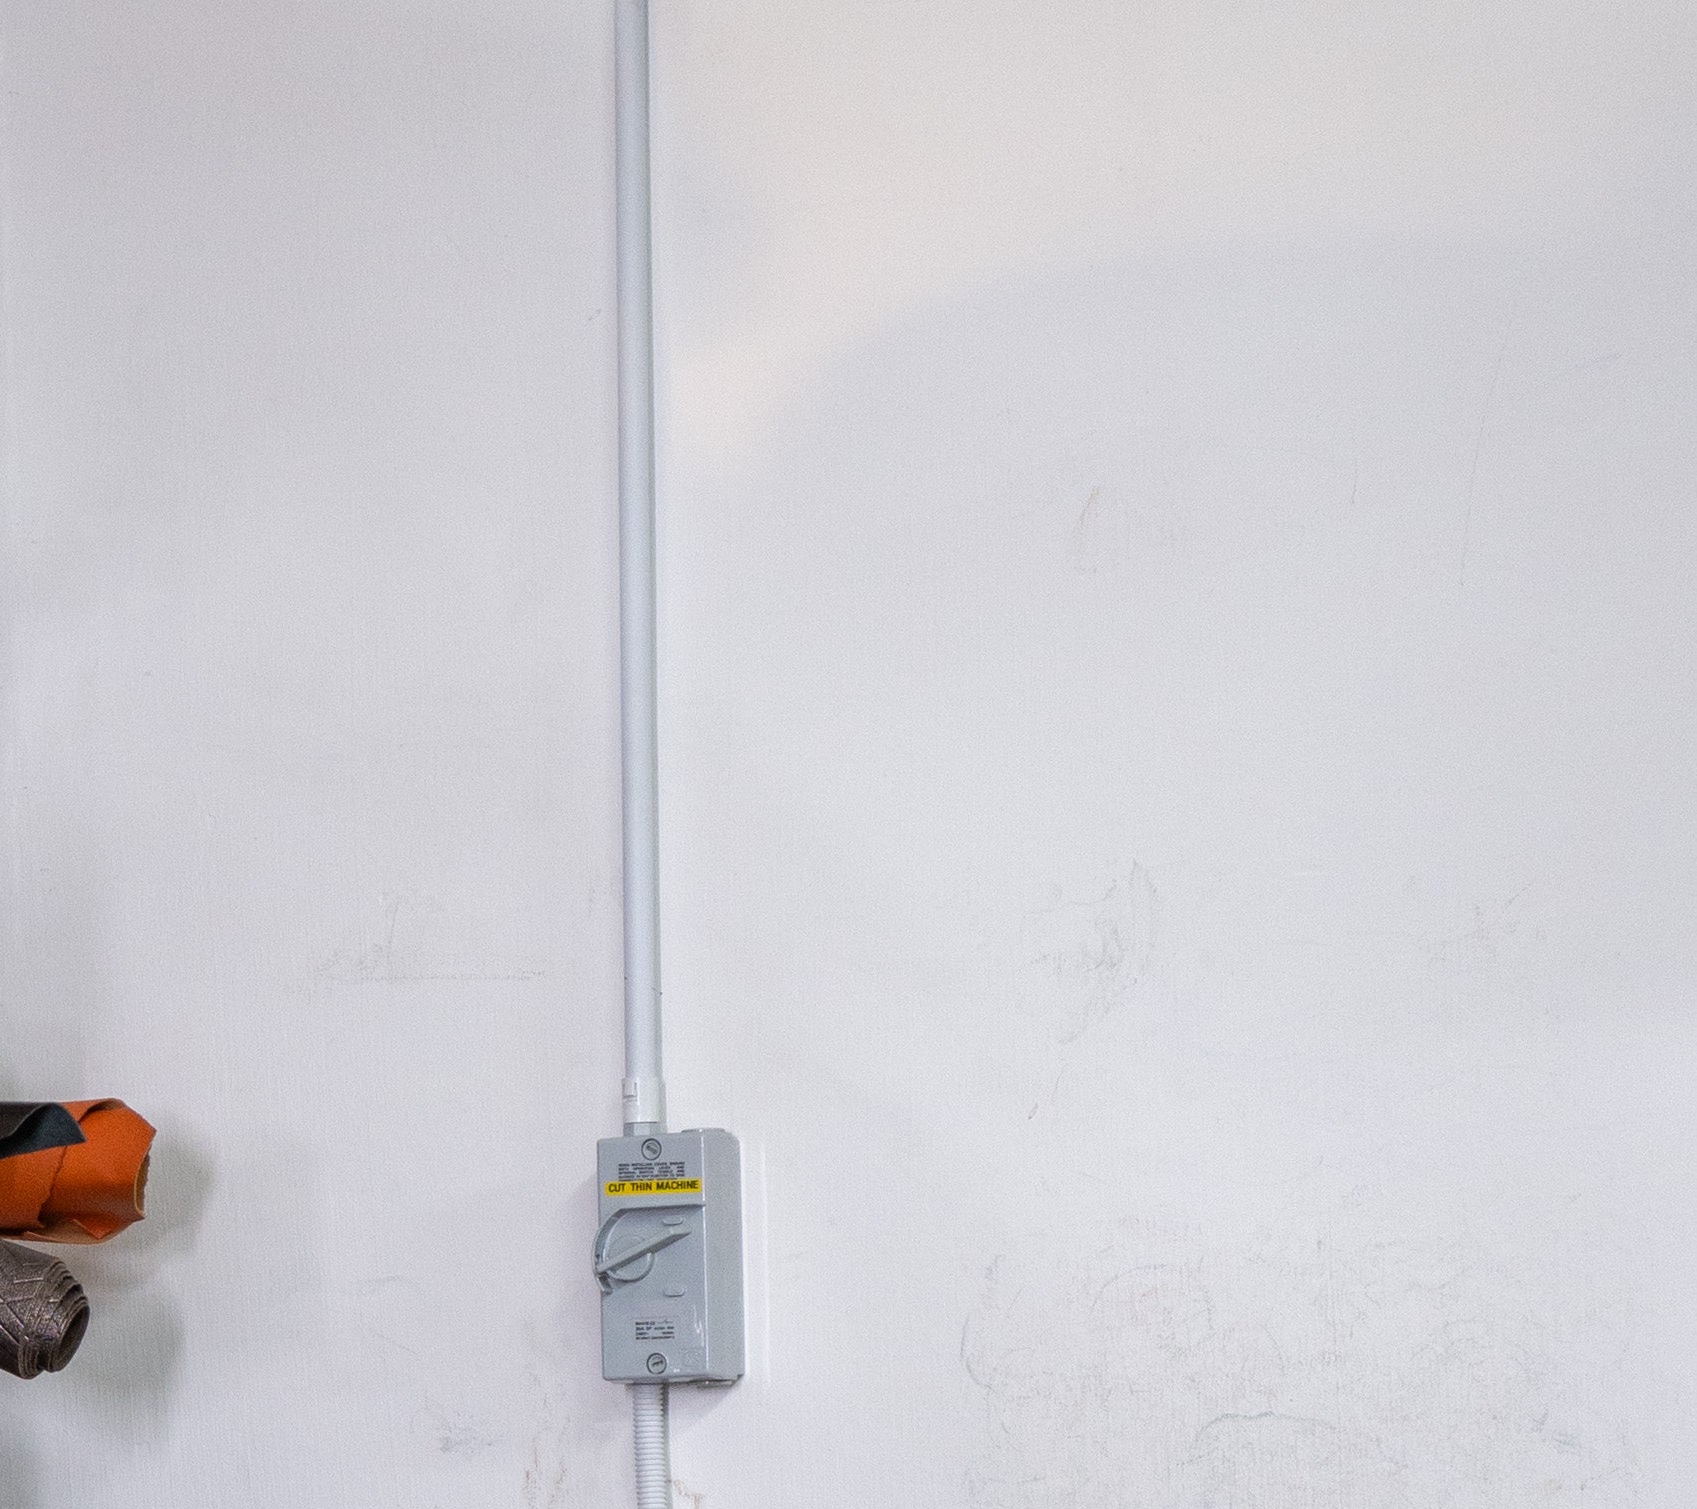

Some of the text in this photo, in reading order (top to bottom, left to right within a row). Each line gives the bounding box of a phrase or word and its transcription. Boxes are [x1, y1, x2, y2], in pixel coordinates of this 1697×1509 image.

[608, 1180, 699, 1193] CUT THIN MACHINE
